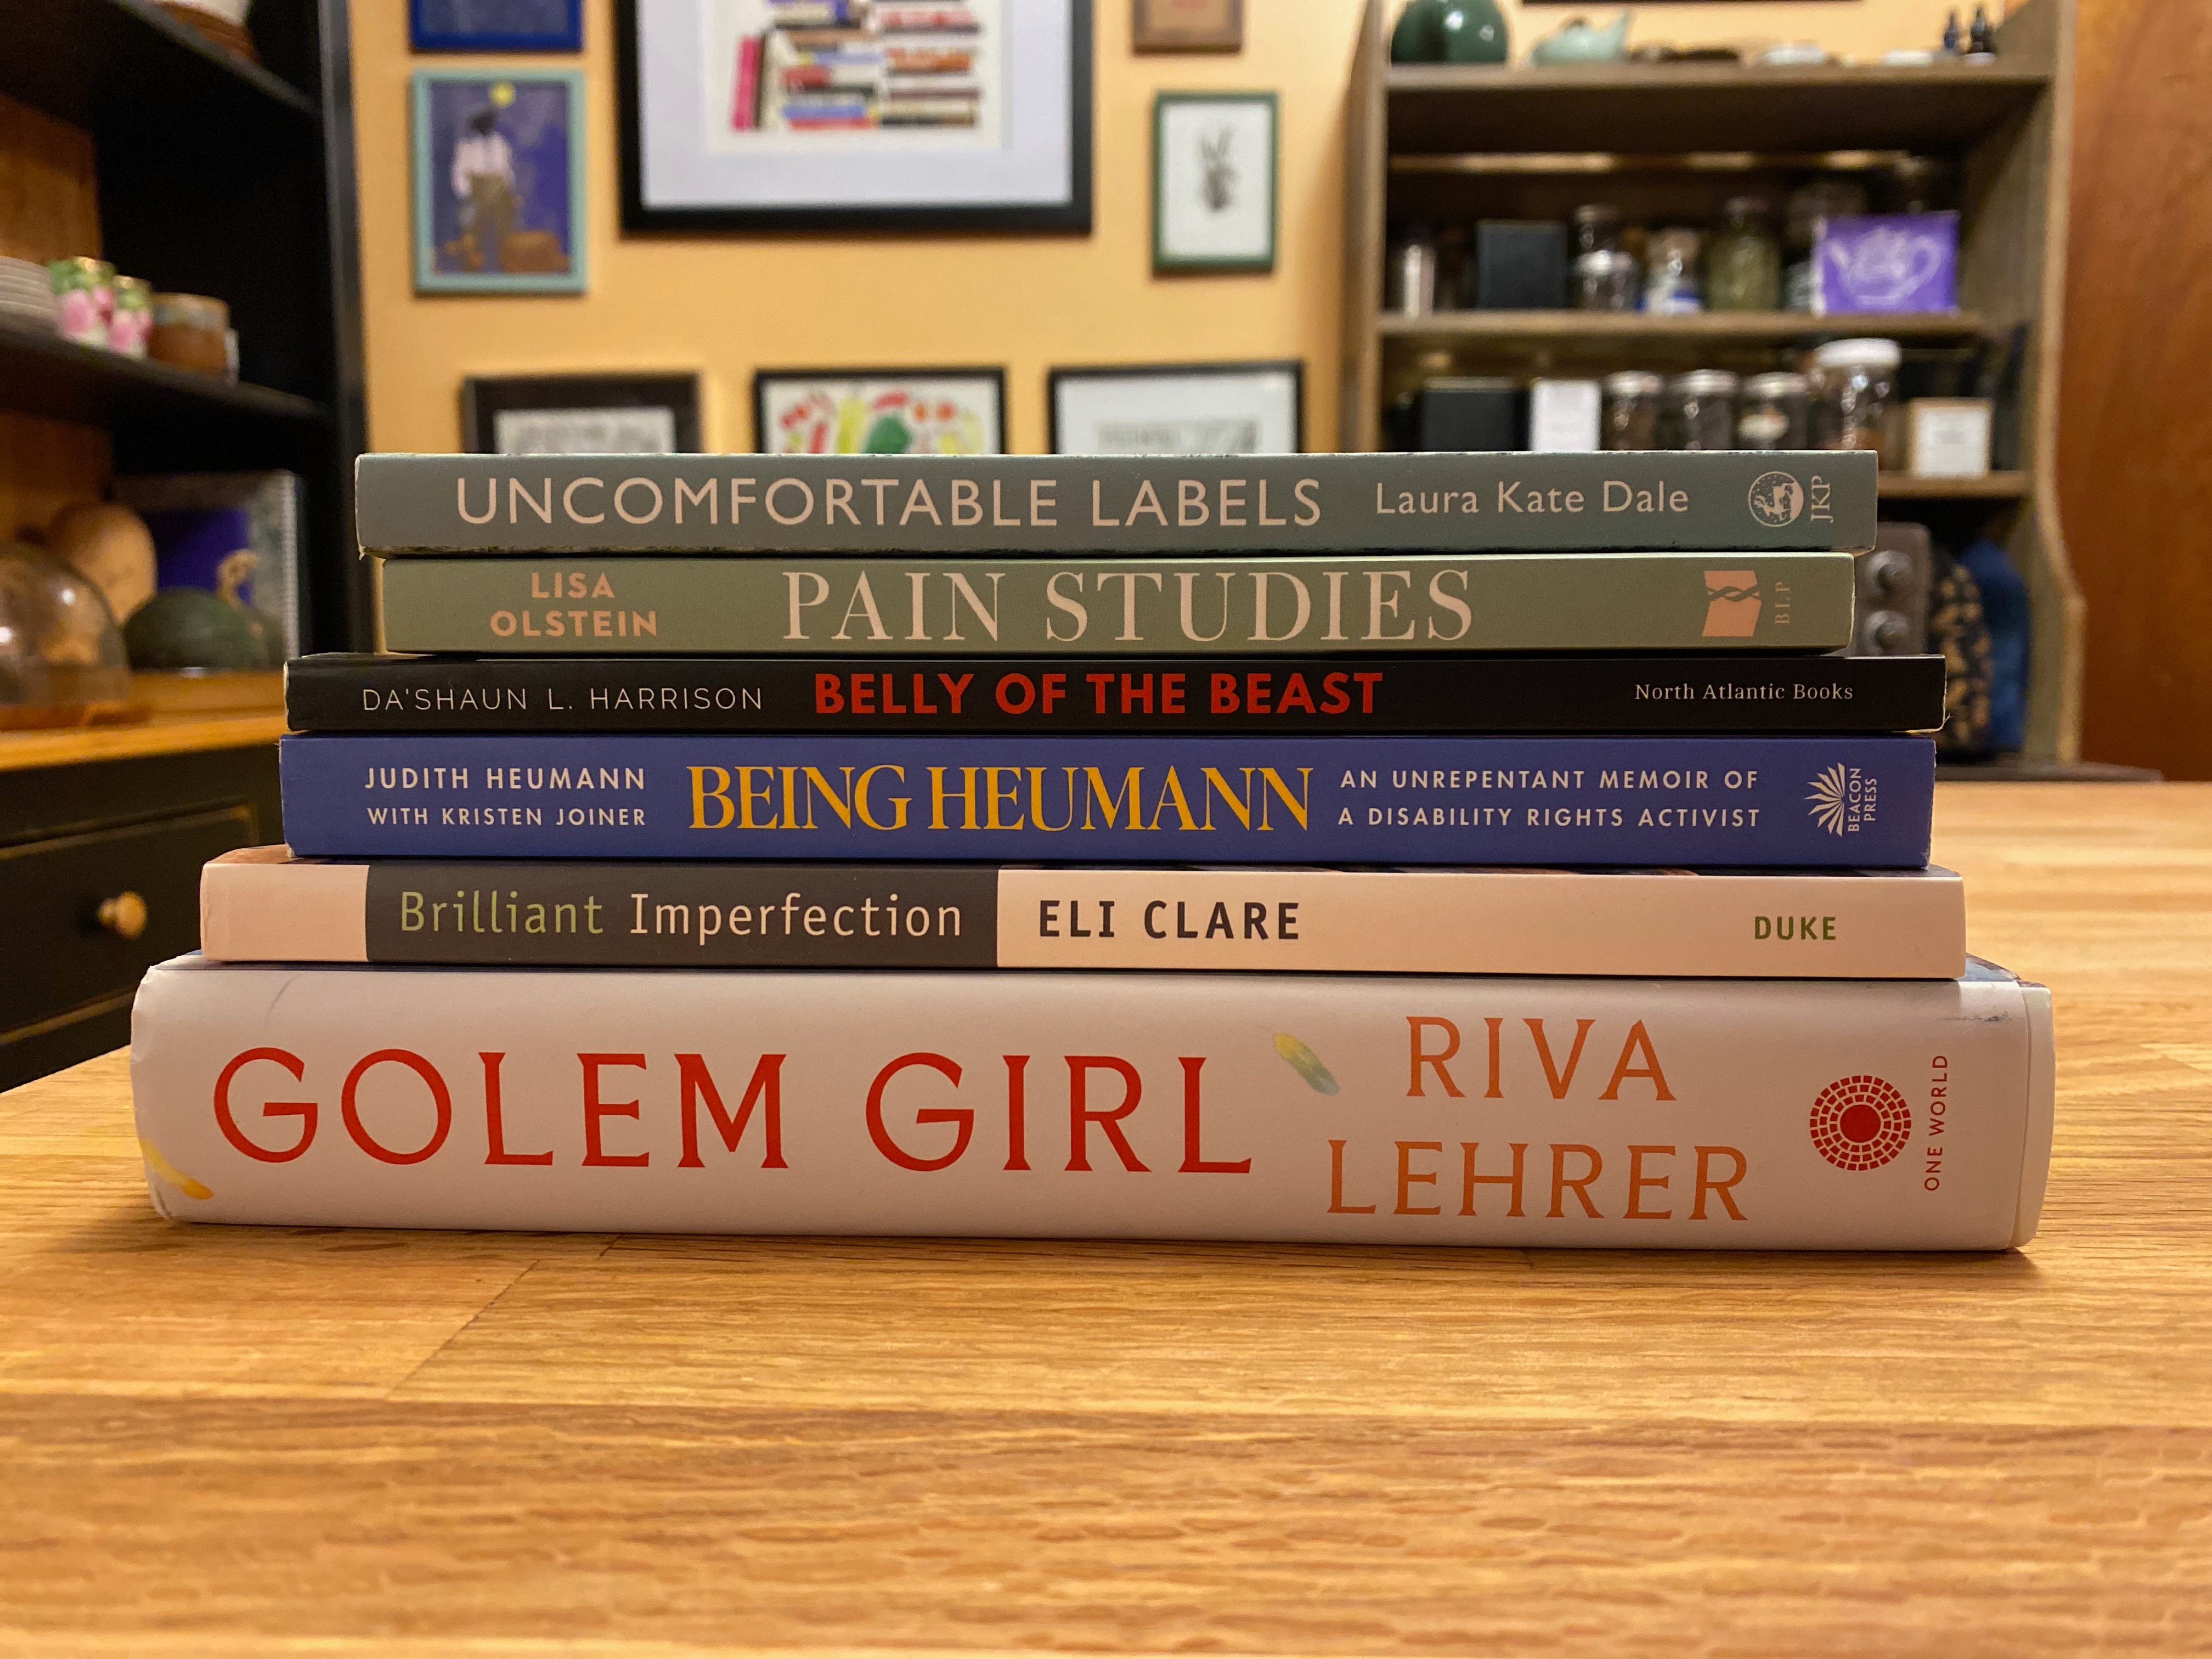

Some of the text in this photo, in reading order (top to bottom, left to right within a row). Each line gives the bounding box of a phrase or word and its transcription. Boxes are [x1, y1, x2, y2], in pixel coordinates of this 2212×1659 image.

[458, 477, 1320, 526] UNCOMFORTABLE LABELS
[1377, 481, 1688, 514] Laura Kate Dale
[532, 572, 614, 598] LISA
[490, 611, 656, 636] OLSTEIN
[783, 570, 1471, 641] PAIN STUDIES
[364, 688, 760, 710] DA'SHAUN L. HARRISON
[815, 673, 1383, 714] BELLY OF THE BEAST
[1636, 683, 1852, 699] North Atlantic Books
[365, 768, 644, 789] JUDITH HEUMANN
[687, 765, 1313, 831] BEING HEUMANN
[1341, 770, 1757, 788] AN UNREPENTANT MEMOIR OF
[367, 808, 645, 825] WITH KRISTEN JOINER
[1339, 808, 1759, 826] A DISABILITY RIGHTS ACTIVIST
[1848, 768, 1861, 831] BEACON
[1864, 778, 1877, 821] PRESS
[402, 890, 960, 945] Brilliant Imperfection
[1040, 900, 1299, 940] ELI CLARE
[1755, 916, 1836, 940] DUKE
[1407, 1017, 1677, 1101] RIVA
[214, 1047, 1251, 1173] GOLEM GIRL
[1925, 1056, 1948, 1190] ONE WORLD
[1327, 1140, 1748, 1221] LEHRER
